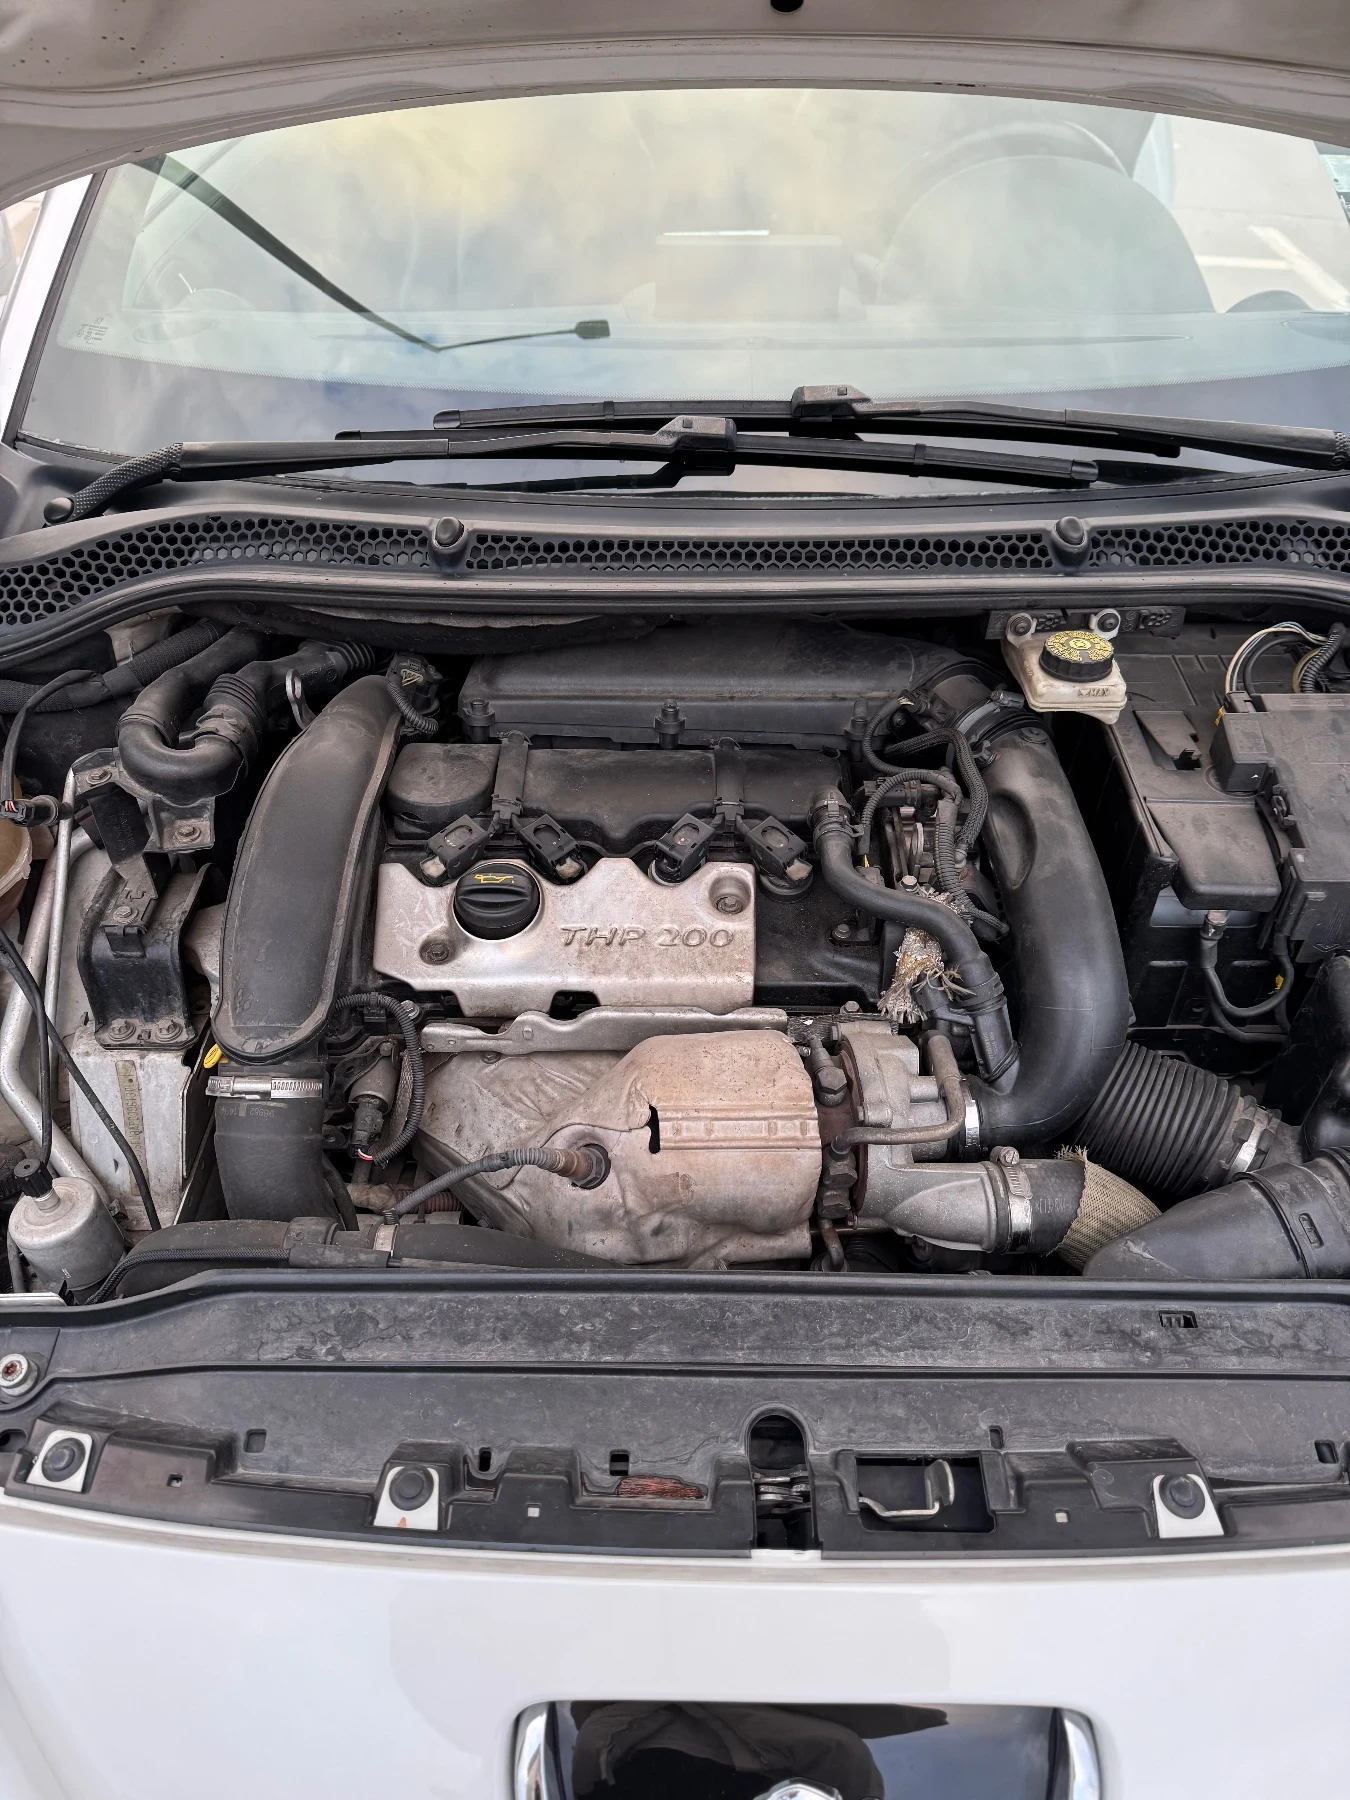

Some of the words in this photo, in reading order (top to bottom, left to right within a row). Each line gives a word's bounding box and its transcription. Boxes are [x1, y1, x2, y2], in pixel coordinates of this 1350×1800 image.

[1090, 688, 1109, 697] MAX
[560, 925, 646, 947] THP
[657, 924, 735, 948] 200
